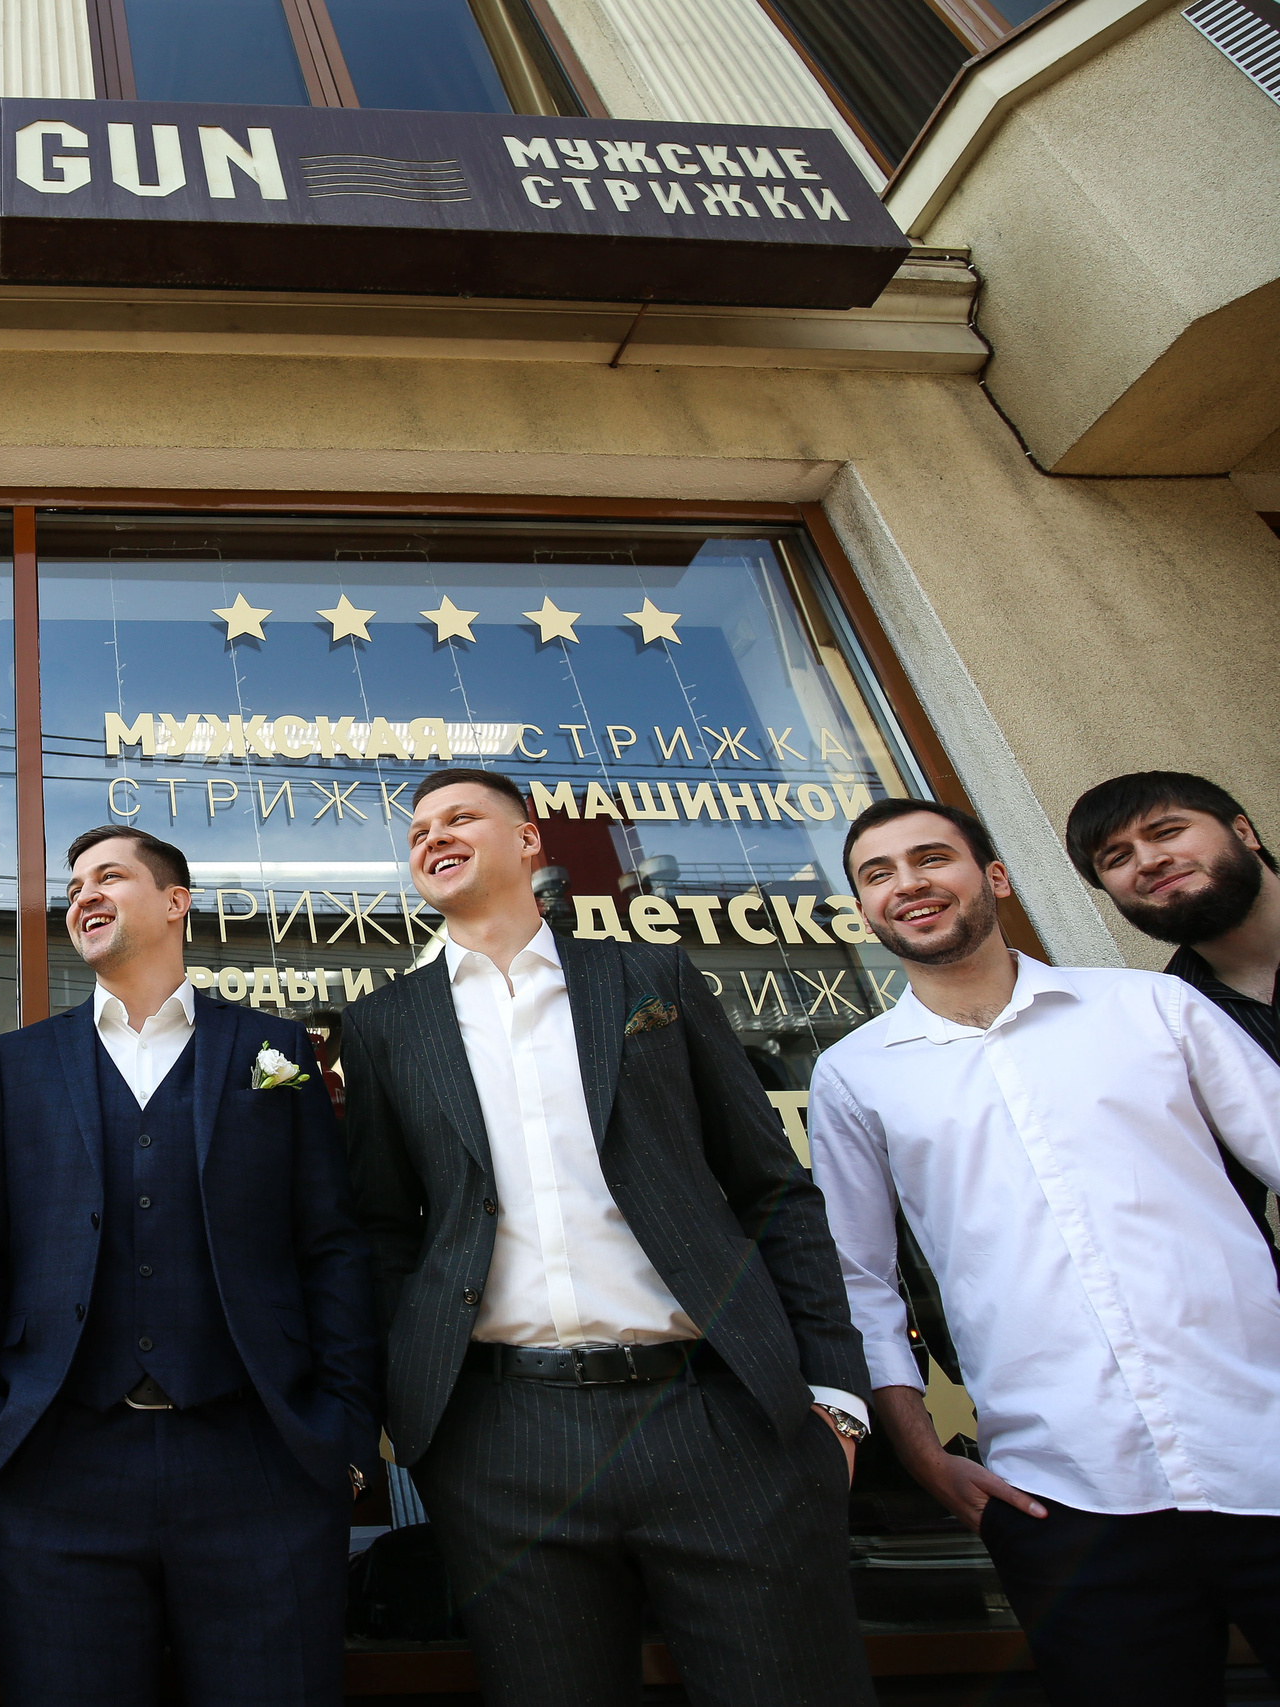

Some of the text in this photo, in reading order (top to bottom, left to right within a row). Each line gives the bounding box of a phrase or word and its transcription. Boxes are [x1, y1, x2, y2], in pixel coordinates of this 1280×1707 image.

[502, 134, 821, 180] МУЖСКИЕ
[521, 174, 850, 221] СТРИЖКИ
[104, 712, 853, 761] МУЖСКАЯ СТРИЖКА
[108, 773, 875, 822] СТРИЖК МАШИНКОЙ
[572, 895, 880, 945] детска
[187, 966, 329, 1008] РОДЫ
